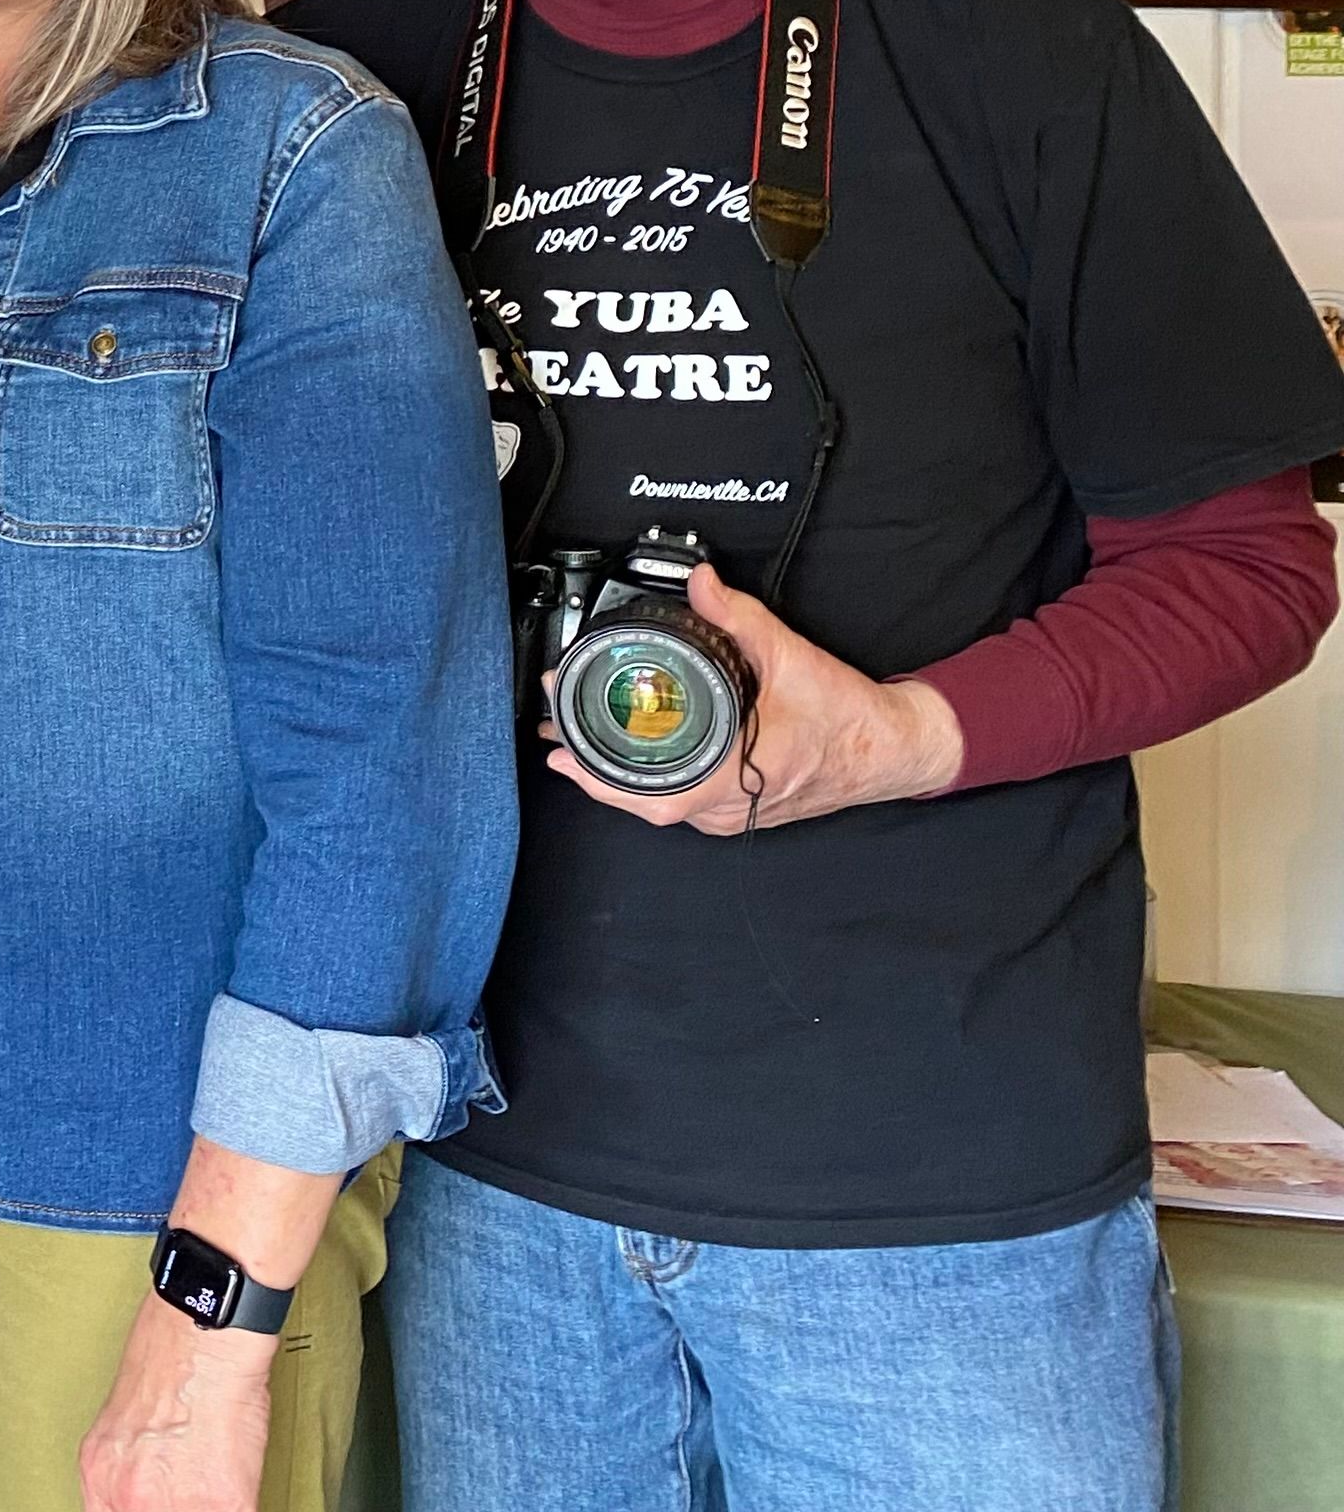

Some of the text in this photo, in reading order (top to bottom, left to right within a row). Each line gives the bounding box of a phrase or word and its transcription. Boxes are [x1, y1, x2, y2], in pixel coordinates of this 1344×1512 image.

[454, 34, 489, 158] DIGITAL
[781, 16, 820, 150] Canon
[485, 174, 644, 231] ebrating
[650, 167, 714, 208] 75
[535, 225, 598, 254] 1940
[622, 225, 694, 252] 2015
[544, 288, 750, 333] YUBA
